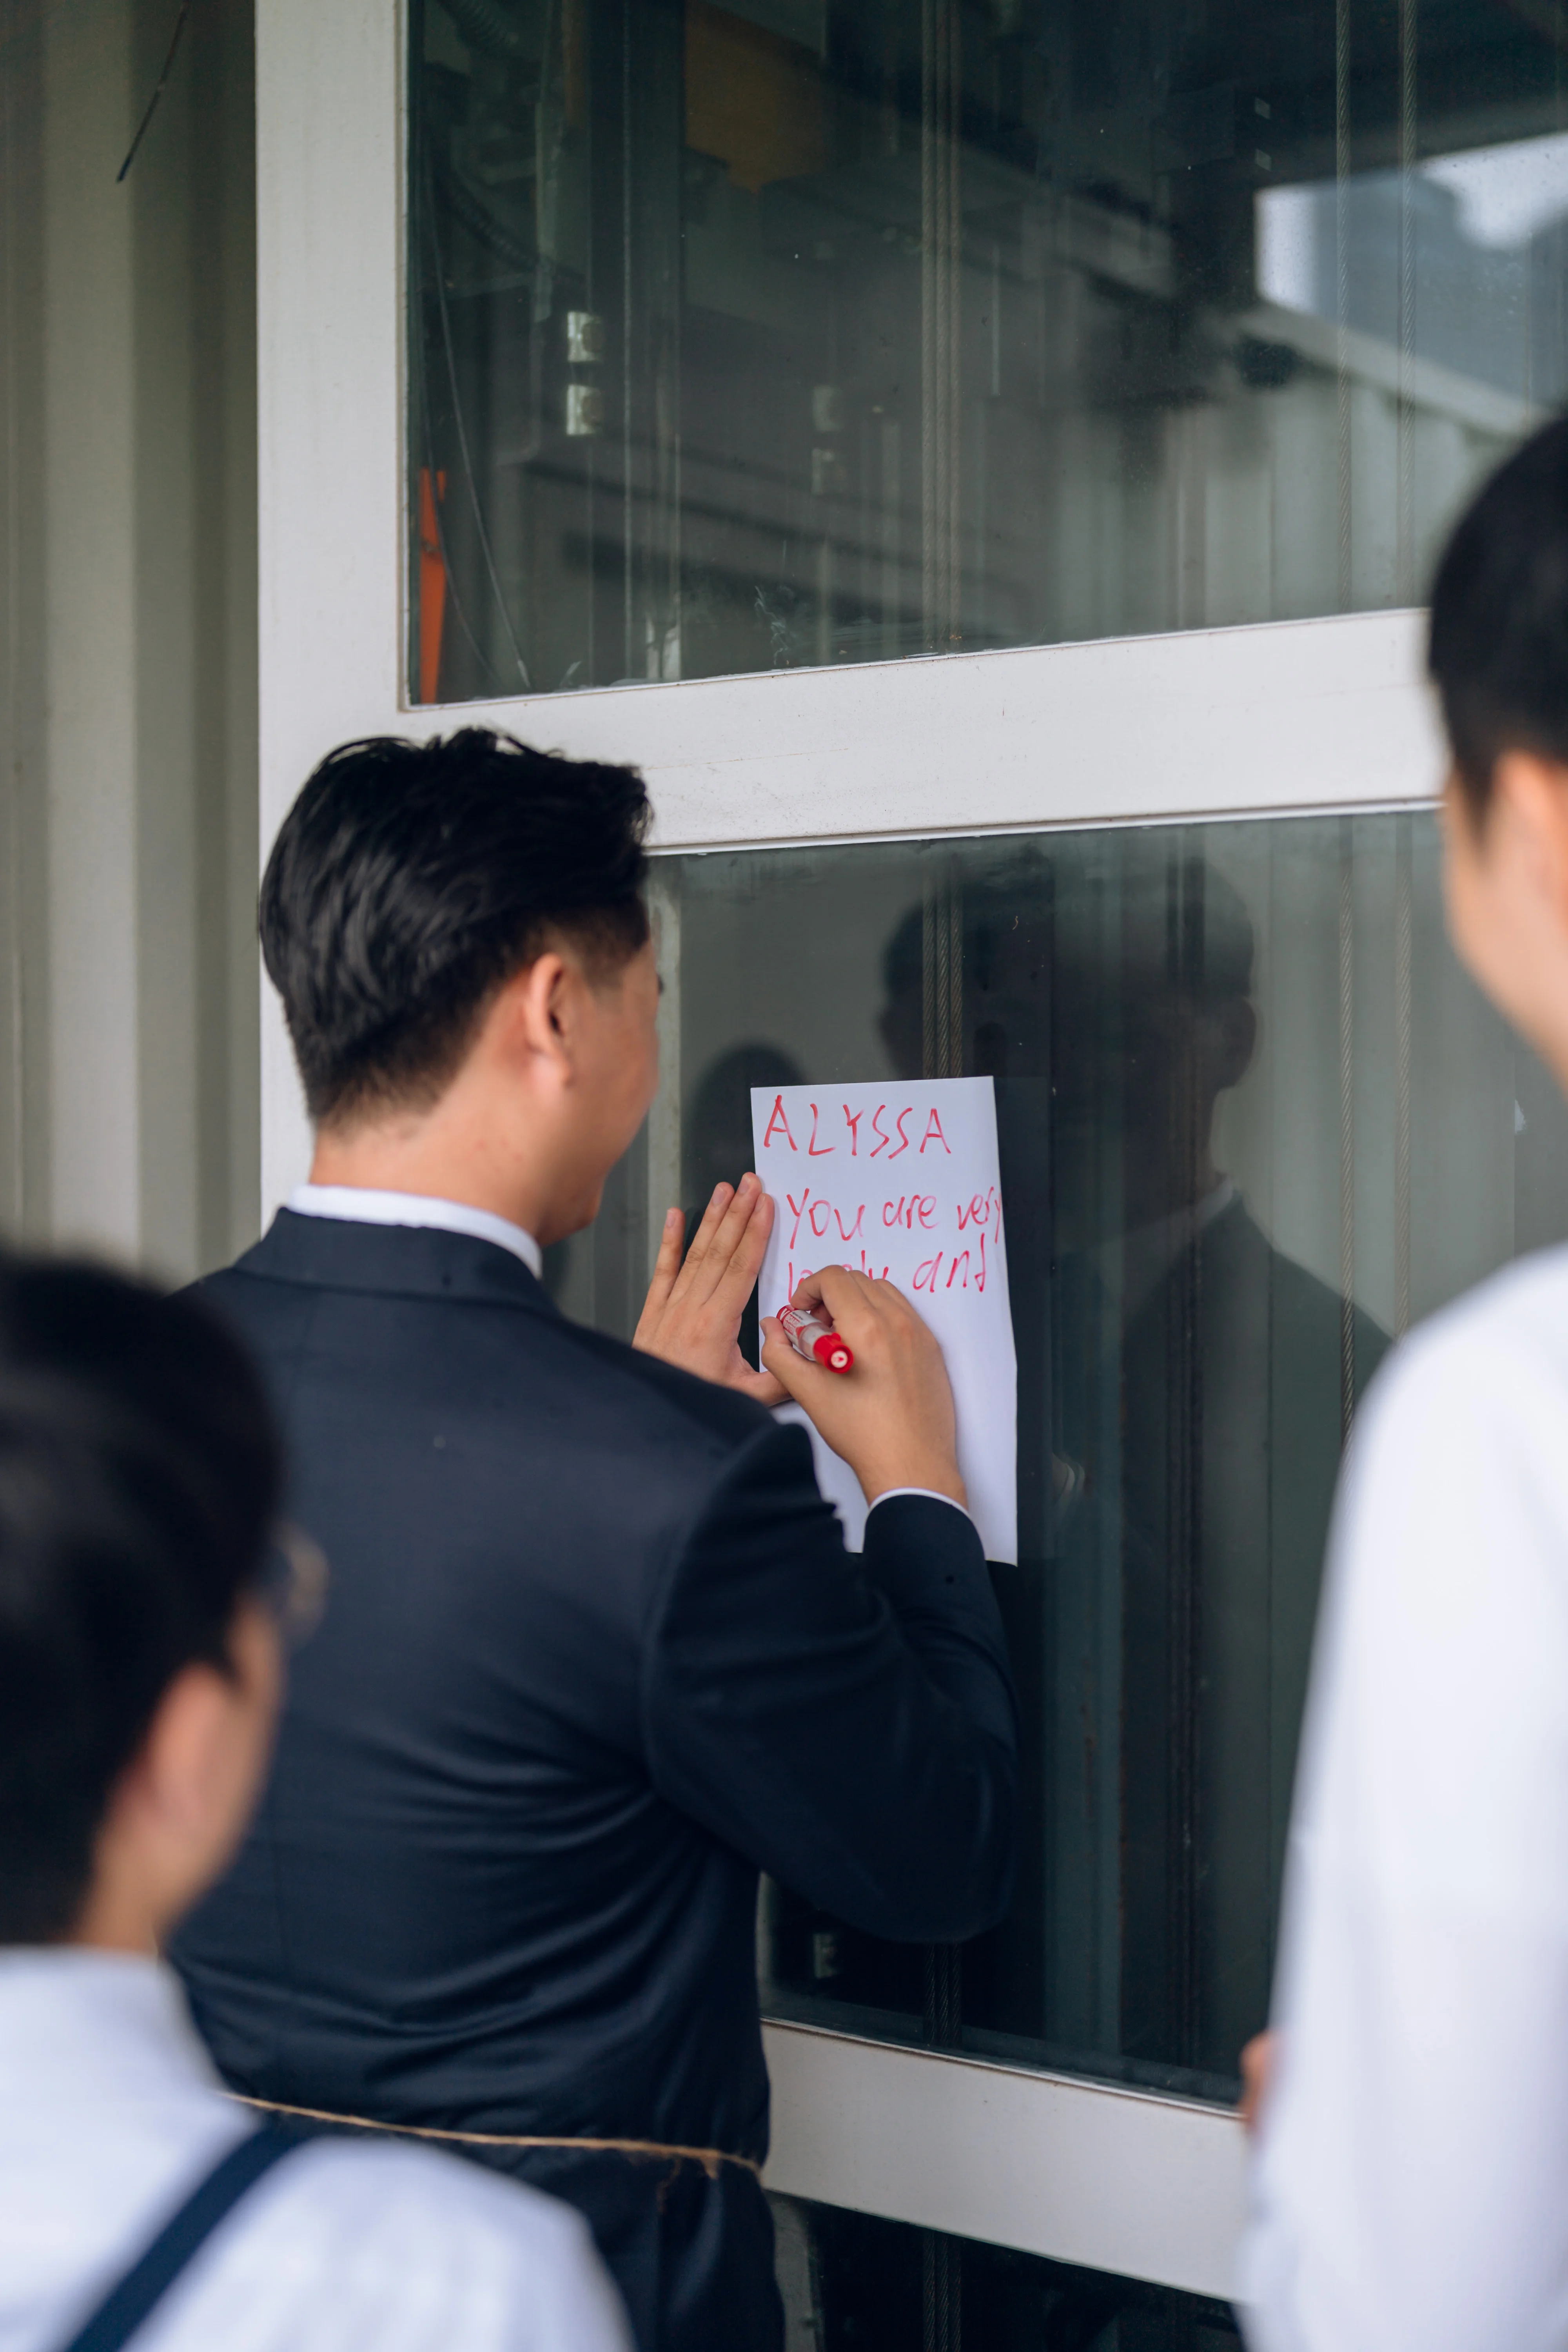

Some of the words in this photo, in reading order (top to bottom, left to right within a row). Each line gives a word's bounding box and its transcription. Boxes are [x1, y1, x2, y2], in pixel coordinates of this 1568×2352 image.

[764, 1094, 951, 1160] ALYSSA
[786, 1188, 866, 1249] You
[882, 1194, 938, 1229] are
[956, 1186, 1002, 1244] very
[912, 1232, 986, 1293] and
